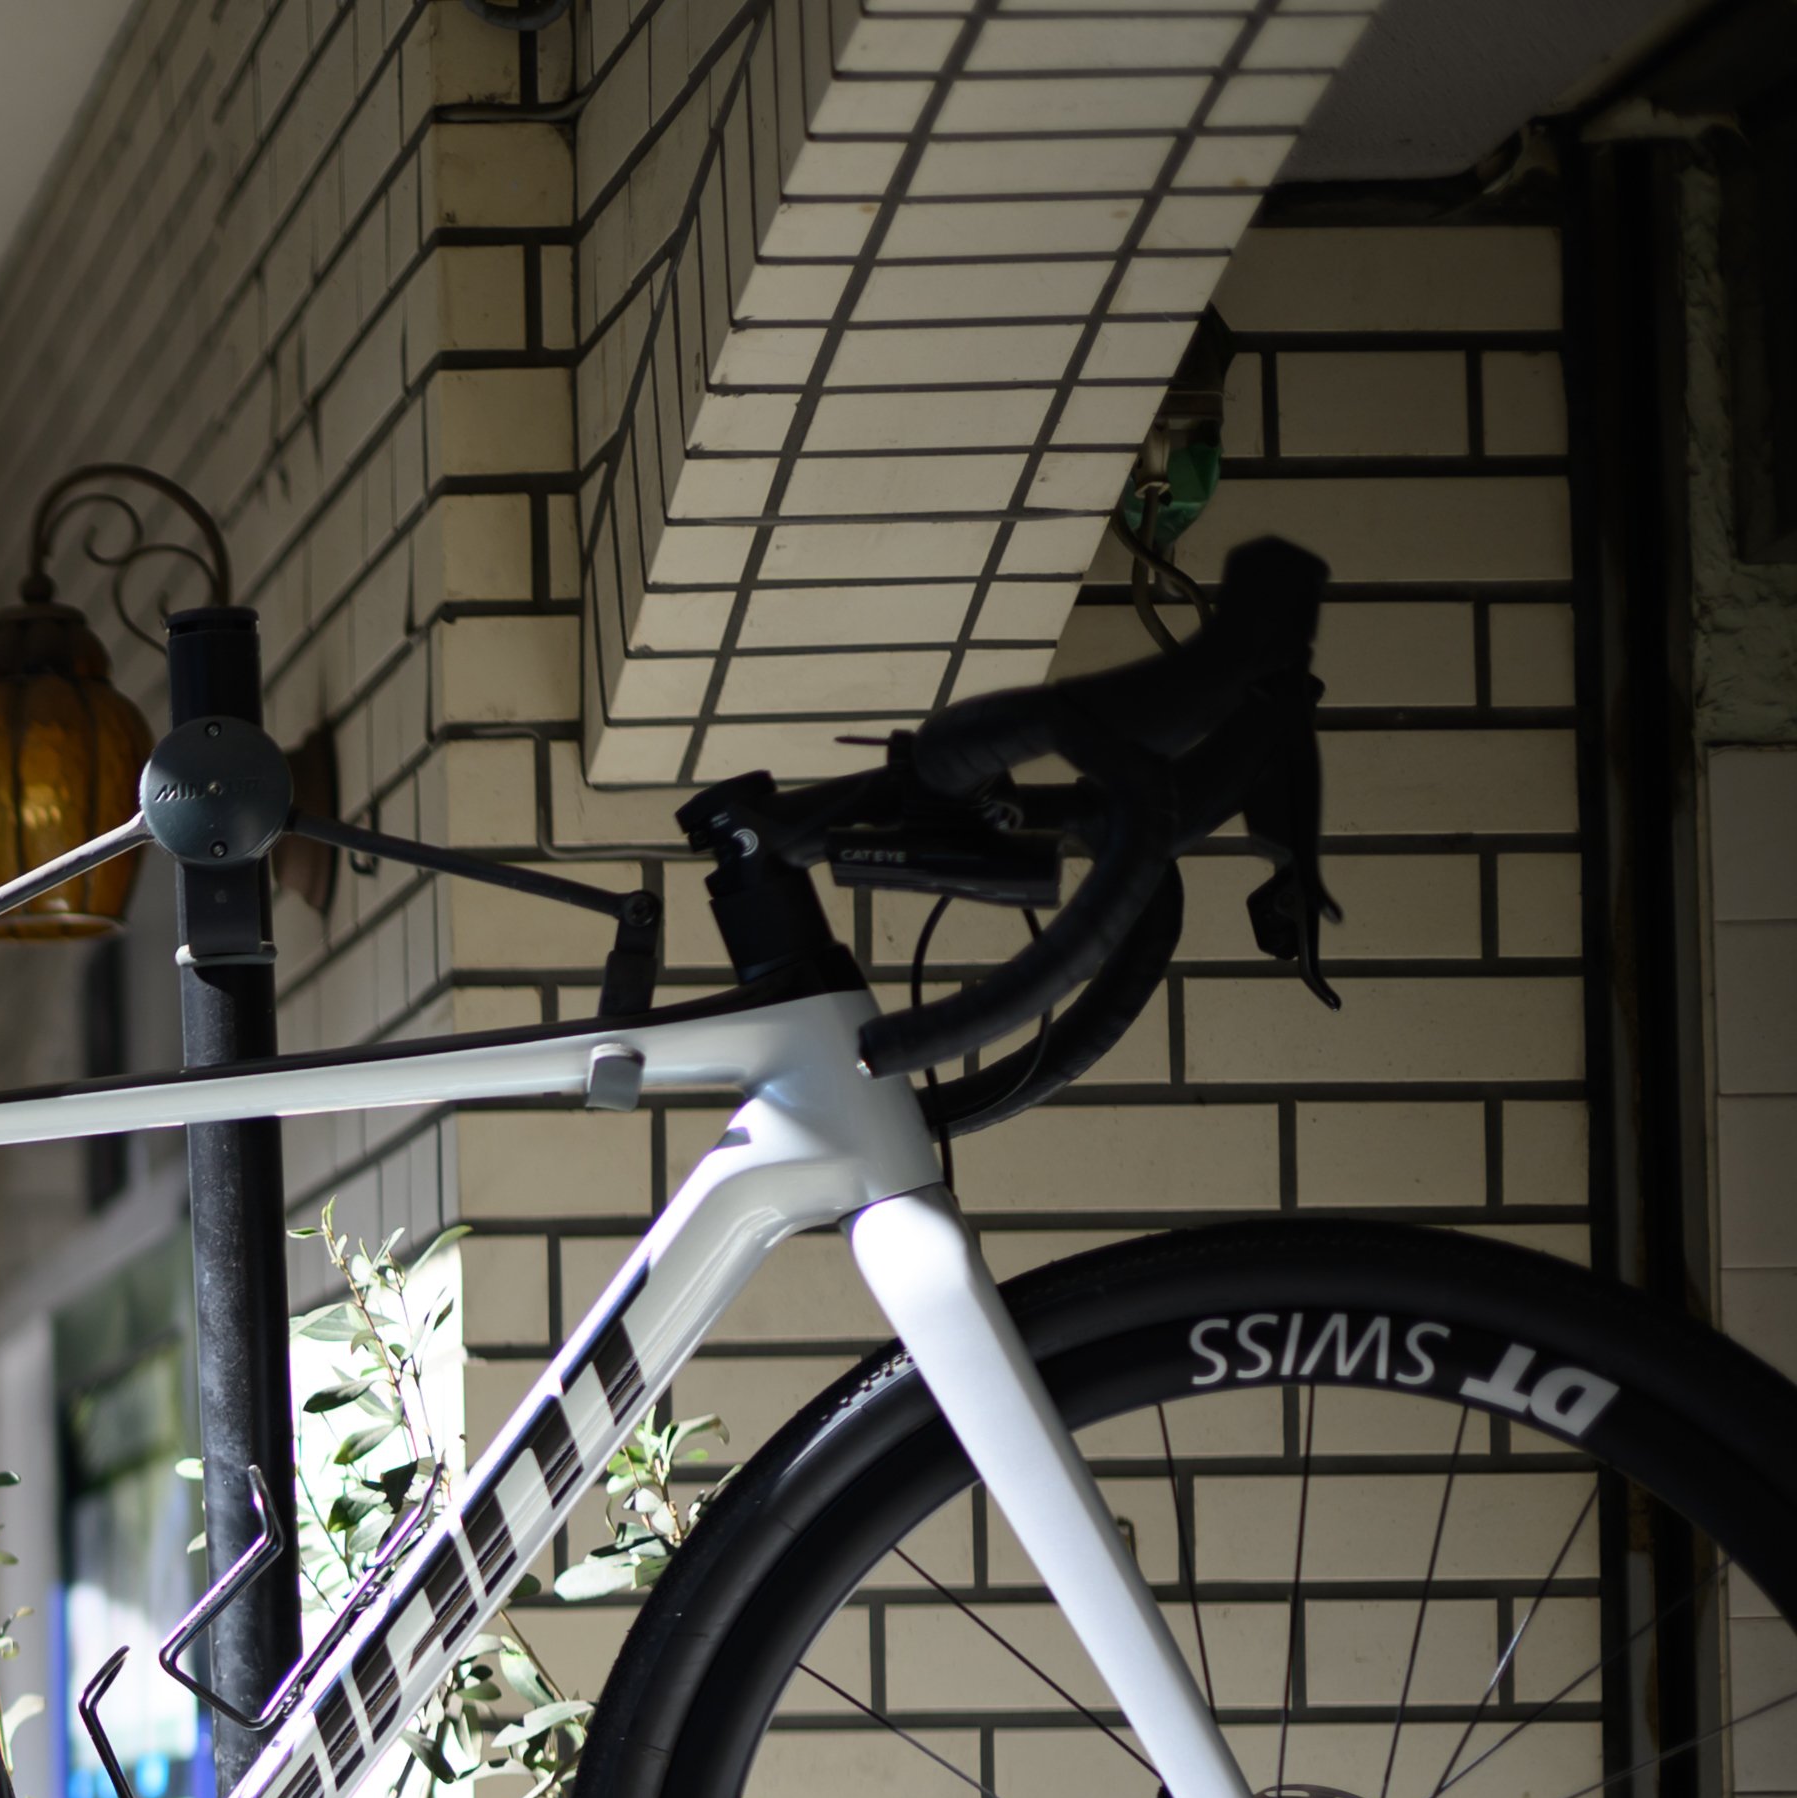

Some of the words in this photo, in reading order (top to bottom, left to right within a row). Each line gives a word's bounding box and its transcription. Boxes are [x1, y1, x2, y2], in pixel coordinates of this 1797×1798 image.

[840, 849, 906, 863] CATEYE
[1189, 1312, 1450, 1387] SWISS
[1460, 1344, 1620, 1438] DT
